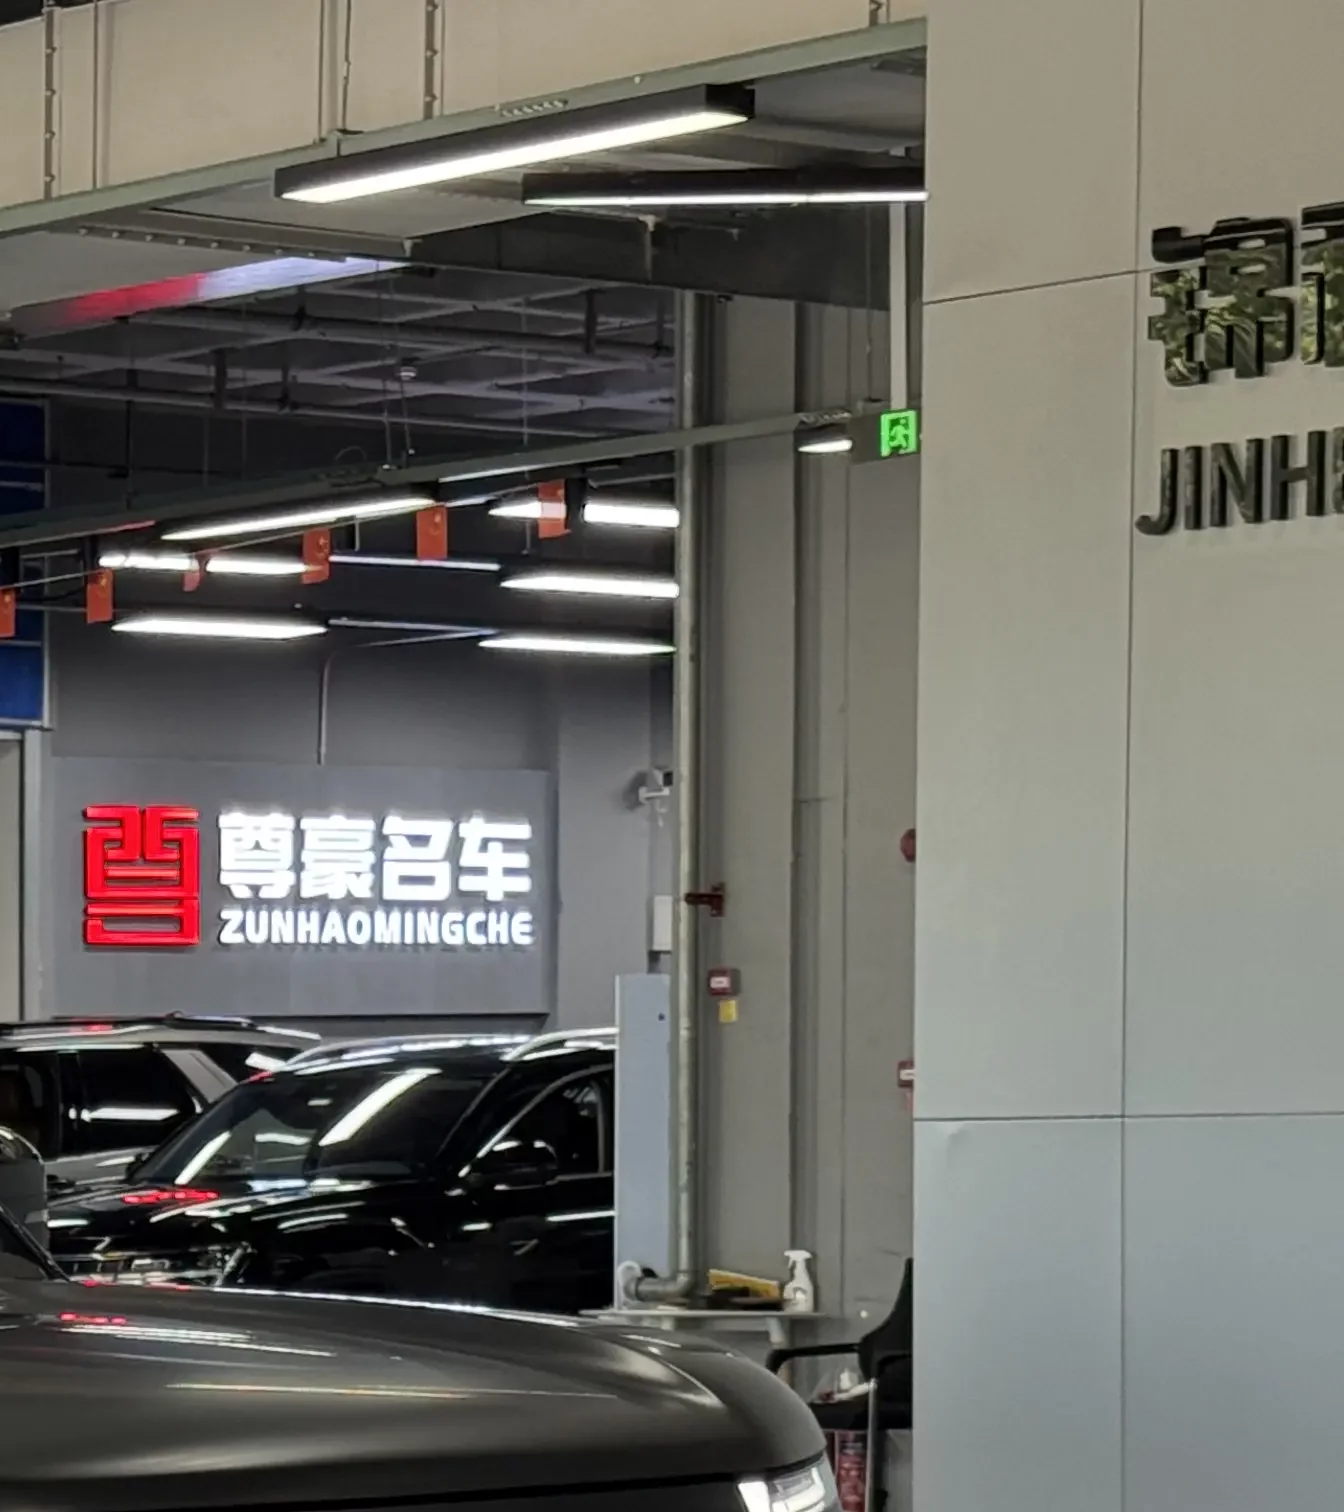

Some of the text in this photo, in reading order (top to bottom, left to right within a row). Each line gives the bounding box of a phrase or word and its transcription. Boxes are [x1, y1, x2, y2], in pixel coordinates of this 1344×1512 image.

[1135, 427, 1344, 536] JINH
[218, 811, 533, 900] 尊豪名车
[219, 909, 534, 945] ZUNHAOMINGCHE
